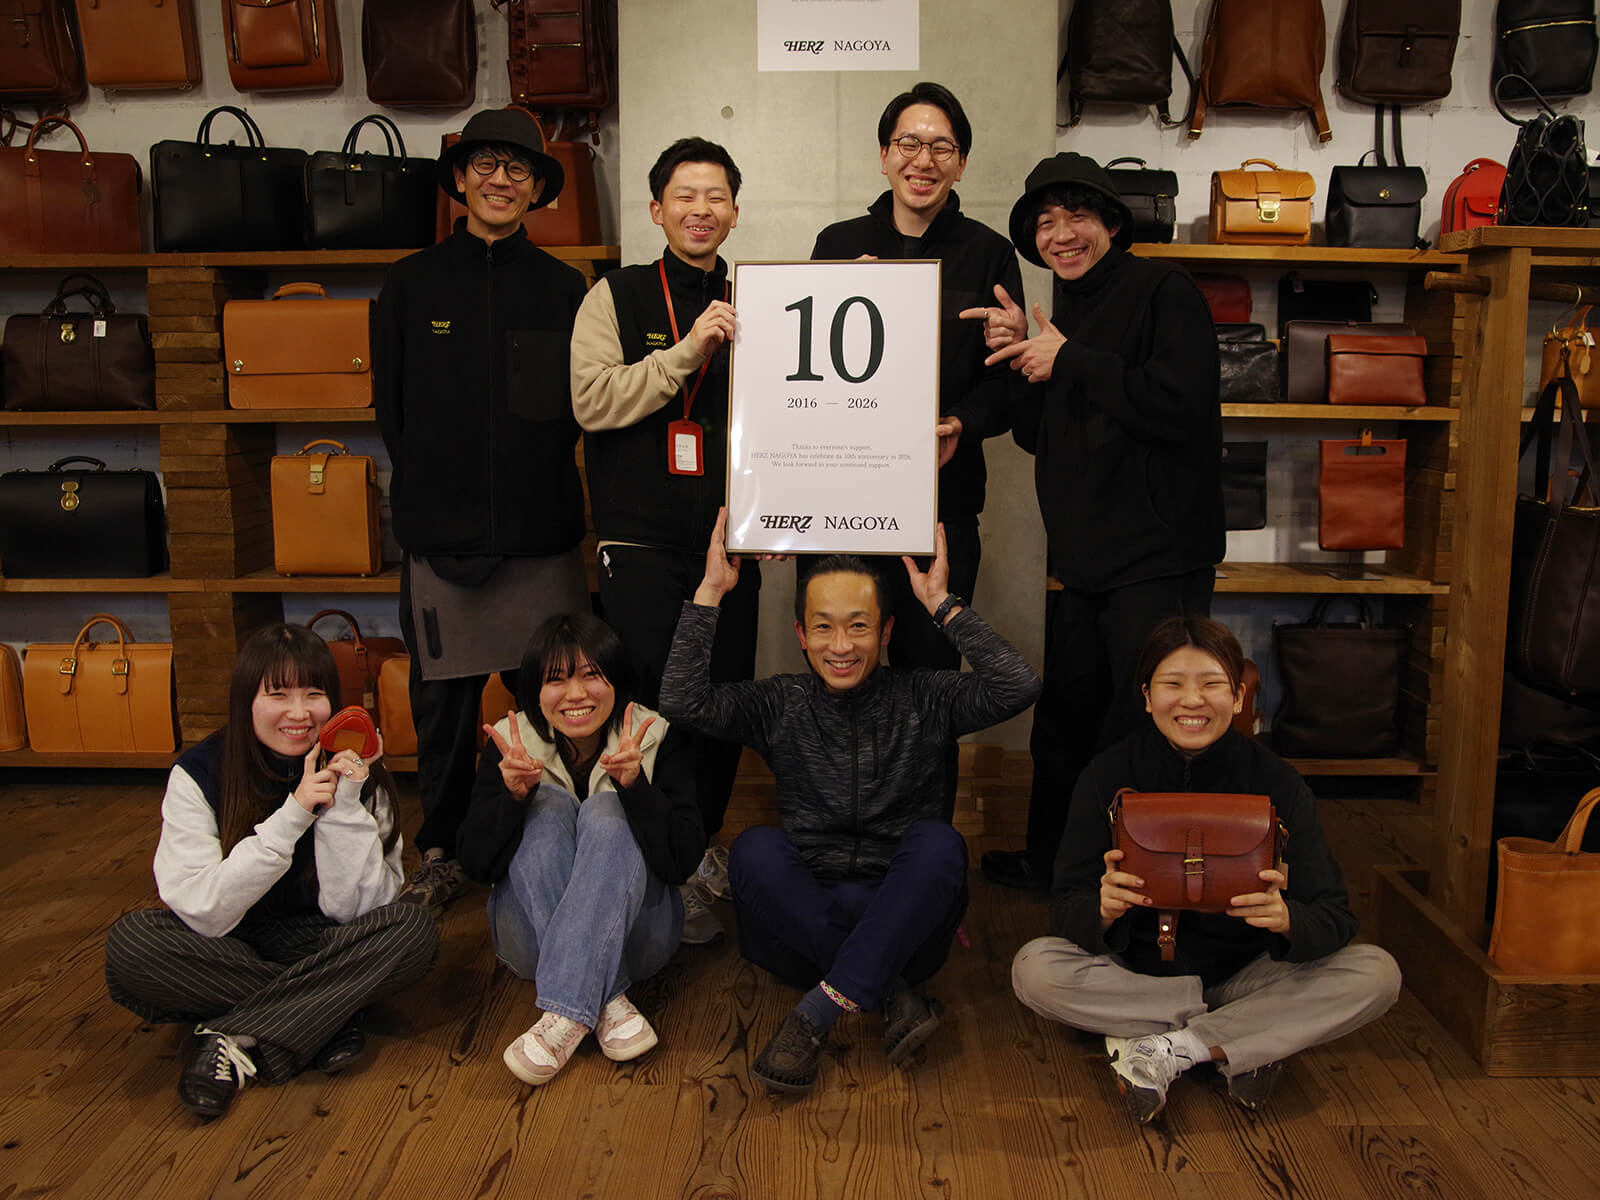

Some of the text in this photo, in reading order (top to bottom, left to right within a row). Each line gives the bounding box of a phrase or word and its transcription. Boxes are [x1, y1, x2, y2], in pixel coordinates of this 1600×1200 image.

[783, 40, 891, 55] HERZ NAGOYA
[646, 332, 667, 341] HERZ
[785, 295, 885, 384] 10
[787, 397, 818, 409] 2016
[847, 397, 878, 409] 2026
[760, 515, 900, 534] HERZ NAGOYA
